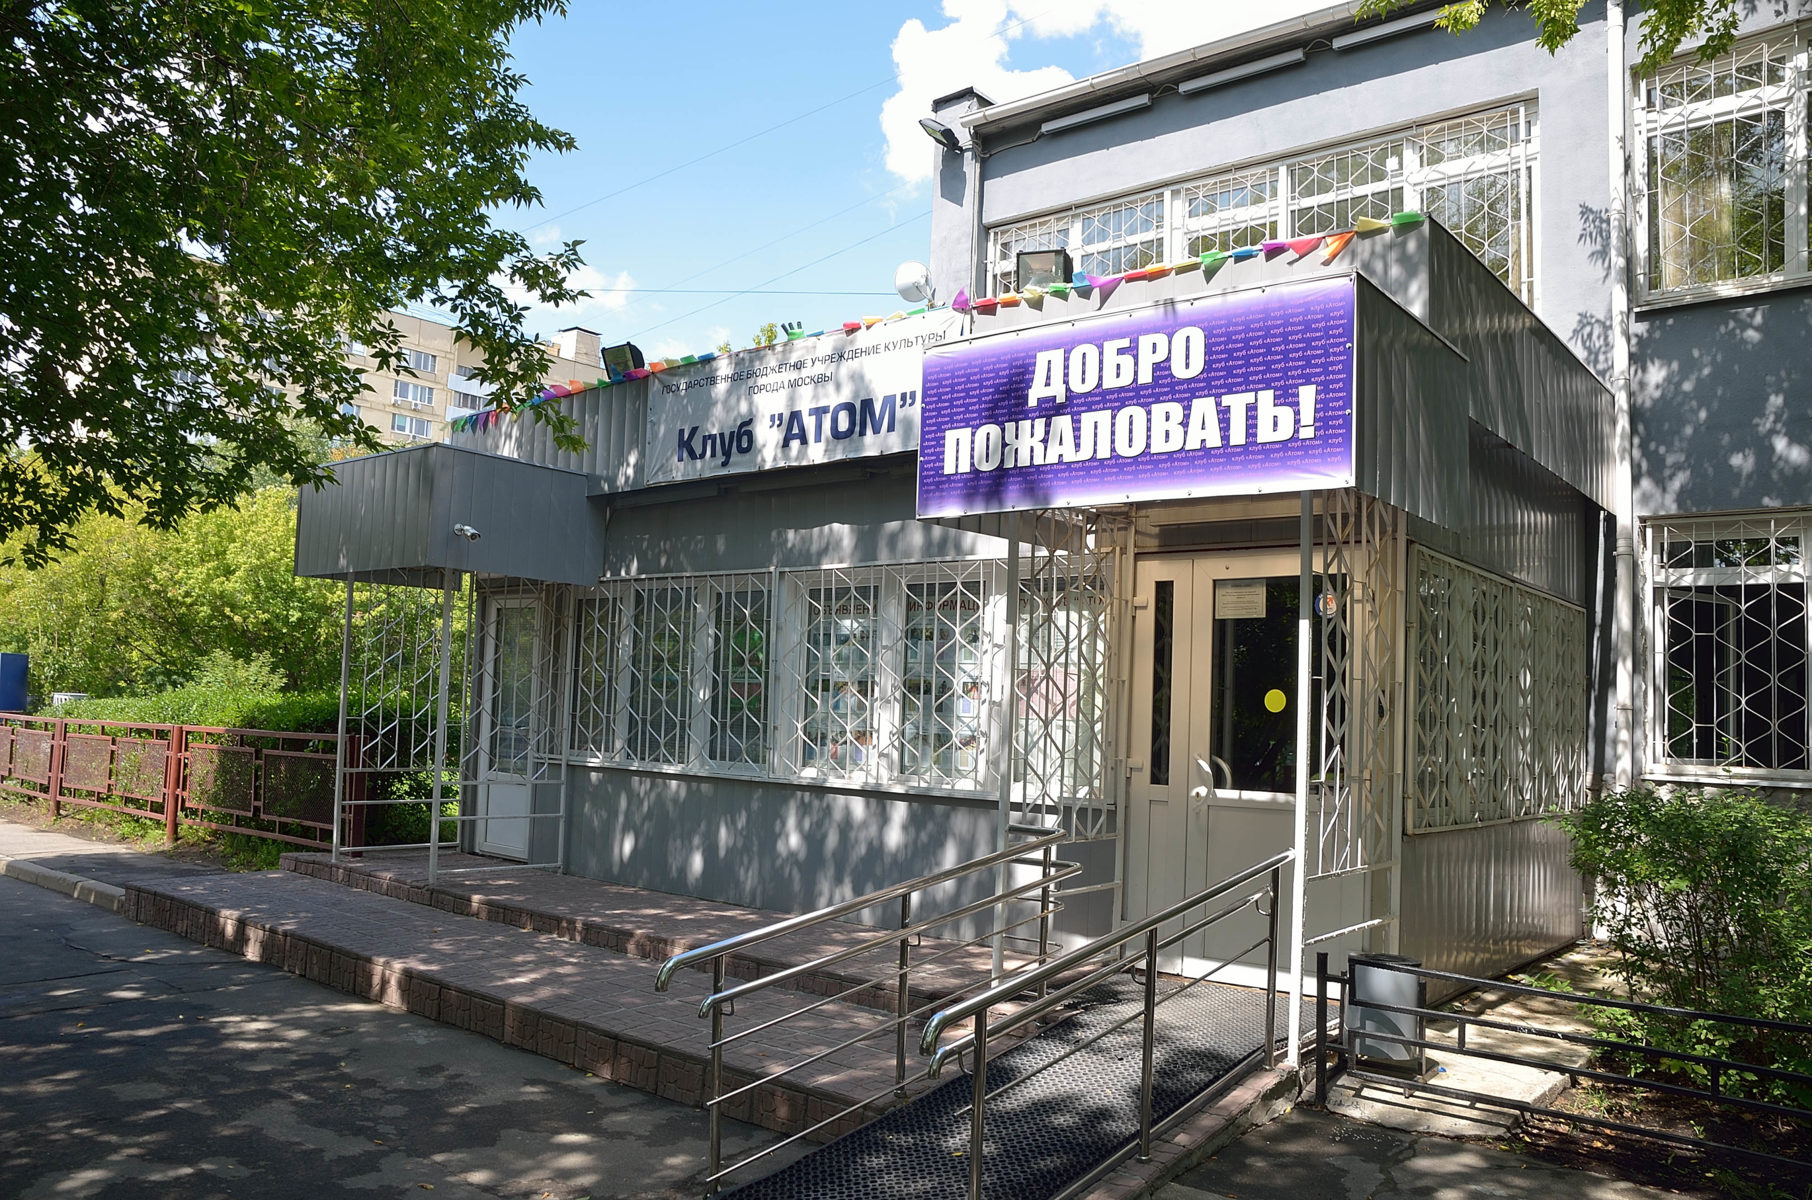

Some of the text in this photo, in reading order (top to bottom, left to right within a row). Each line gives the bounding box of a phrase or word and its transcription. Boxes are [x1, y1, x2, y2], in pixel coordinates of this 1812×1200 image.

[1210, 318, 1227, 326] «Атом»
[1247, 312, 1265, 320] «Атом»
[1271, 309, 1284, 317] клуб
[1285, 306, 1304, 314] «Атом»
[1310, 303, 1324, 311] клуб
[1326, 300, 1346, 308] «Атом»
[1265, 318, 1284, 326] «Атом»
[1290, 315, 1303, 323] клуб
[1305, 312, 1324, 320] «Атом»
[1330, 309, 1344, 317] клуб
[1226, 341, 1244, 349] «Атом»
[1304, 330, 1323, 338] «Атом»
[1329, 327, 1343, 335] клуб
[1285, 324, 1304, 332] «Атом»
[1210, 352, 1228, 360] «Атом»
[1327, 336, 1347, 344] «Атом»
[1265, 353, 1283, 361] «Атом»
[1304, 348, 1323, 356] «Атом»
[661, 329, 946, 395] ГОСУДАРСТВЕННОЕ БЮДЖЕТНОЕ УЧРЕЖДЕНИЕ КУЛЬТУРЫ
[1028, 326, 1206, 407] ДОБРО
[1286, 359, 1305, 367] «Атом»
[1327, 354, 1347, 362] «Атом»
[1303, 366, 1322, 374] «Атом»
[748, 371, 833, 396] ГОРОДА МОСКВЫ
[1286, 377, 1305, 385] «Атом»
[1326, 372, 1346, 380] «Атом»
[677, 402, 754, 467] Клуб
[943, 384, 1317, 476] ПОЖАЛОВАТЬ!
